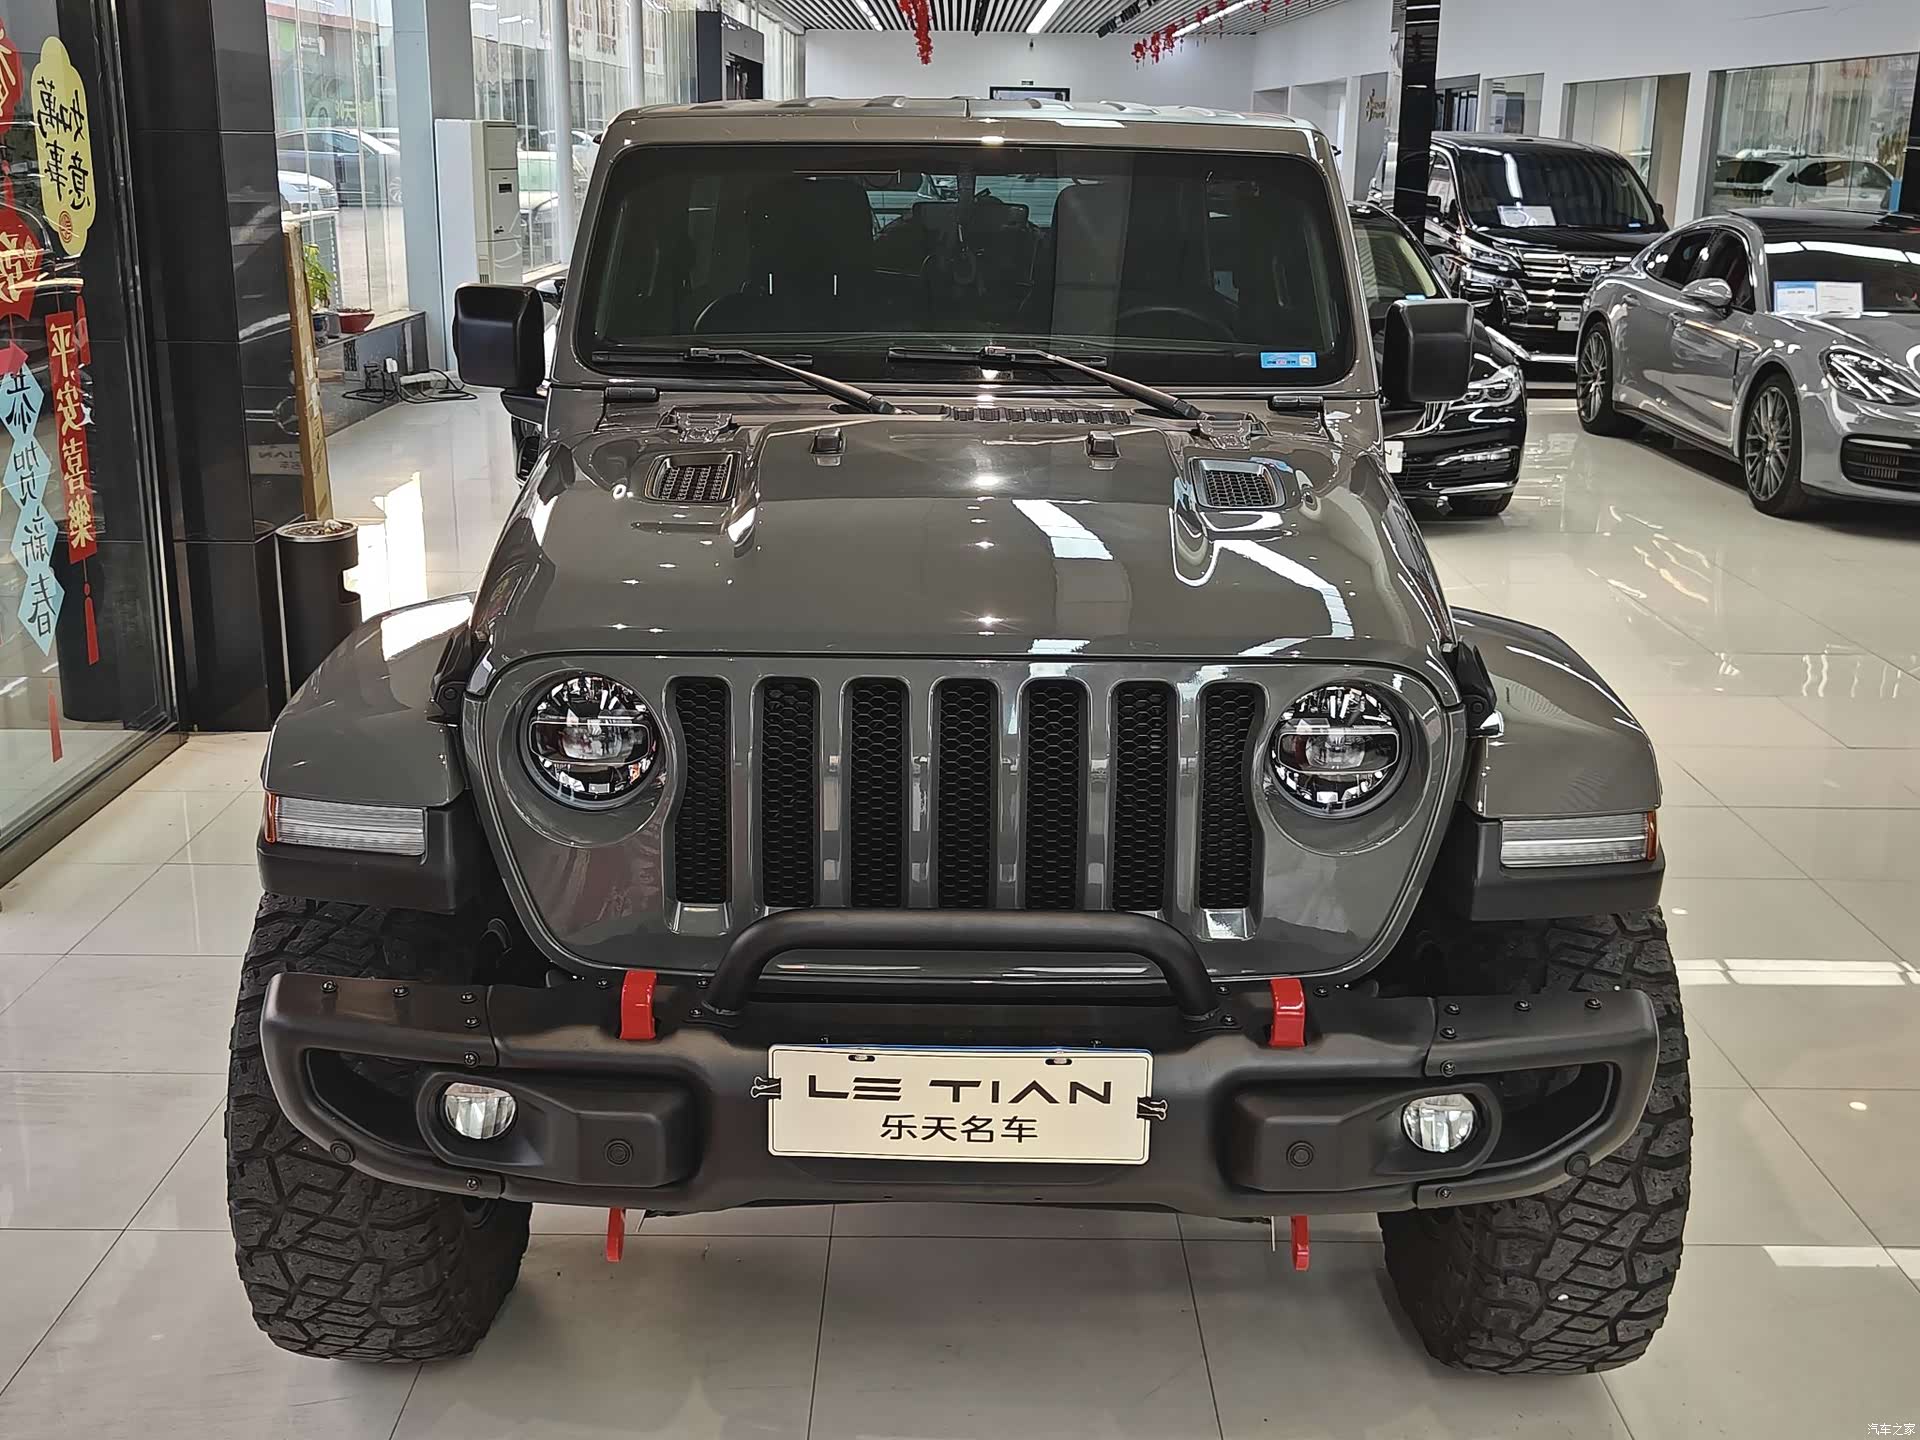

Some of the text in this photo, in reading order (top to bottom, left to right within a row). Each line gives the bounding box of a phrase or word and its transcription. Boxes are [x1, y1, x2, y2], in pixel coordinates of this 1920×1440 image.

[808, 1074, 1112, 1104] LE TIAN
[880, 1113, 1039, 1144] 乐天名车
